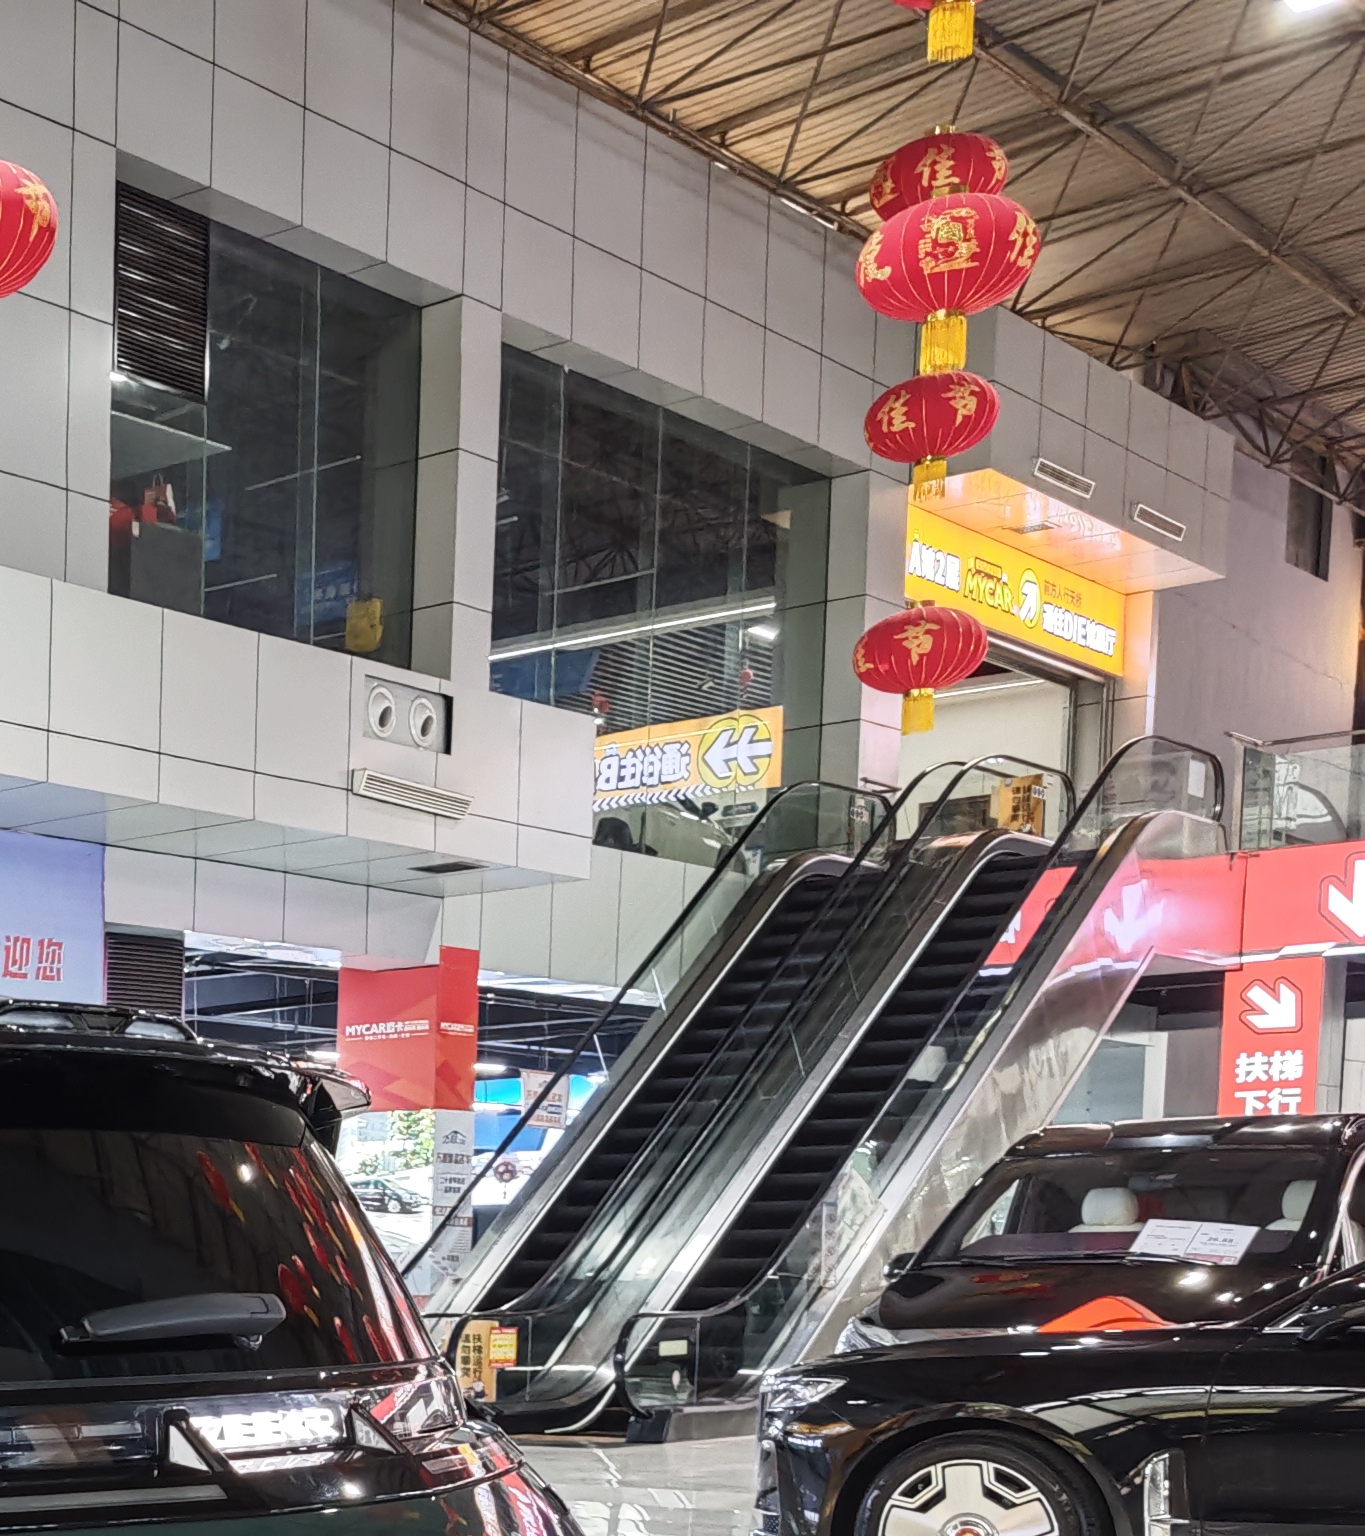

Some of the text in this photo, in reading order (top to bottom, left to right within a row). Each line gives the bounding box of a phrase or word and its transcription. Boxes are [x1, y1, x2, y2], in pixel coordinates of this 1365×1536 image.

[963, 569, 1018, 616] MYCAR
[1234, 1049, 1304, 1083] 扶梯
[1234, 1087, 1302, 1116] 下行
